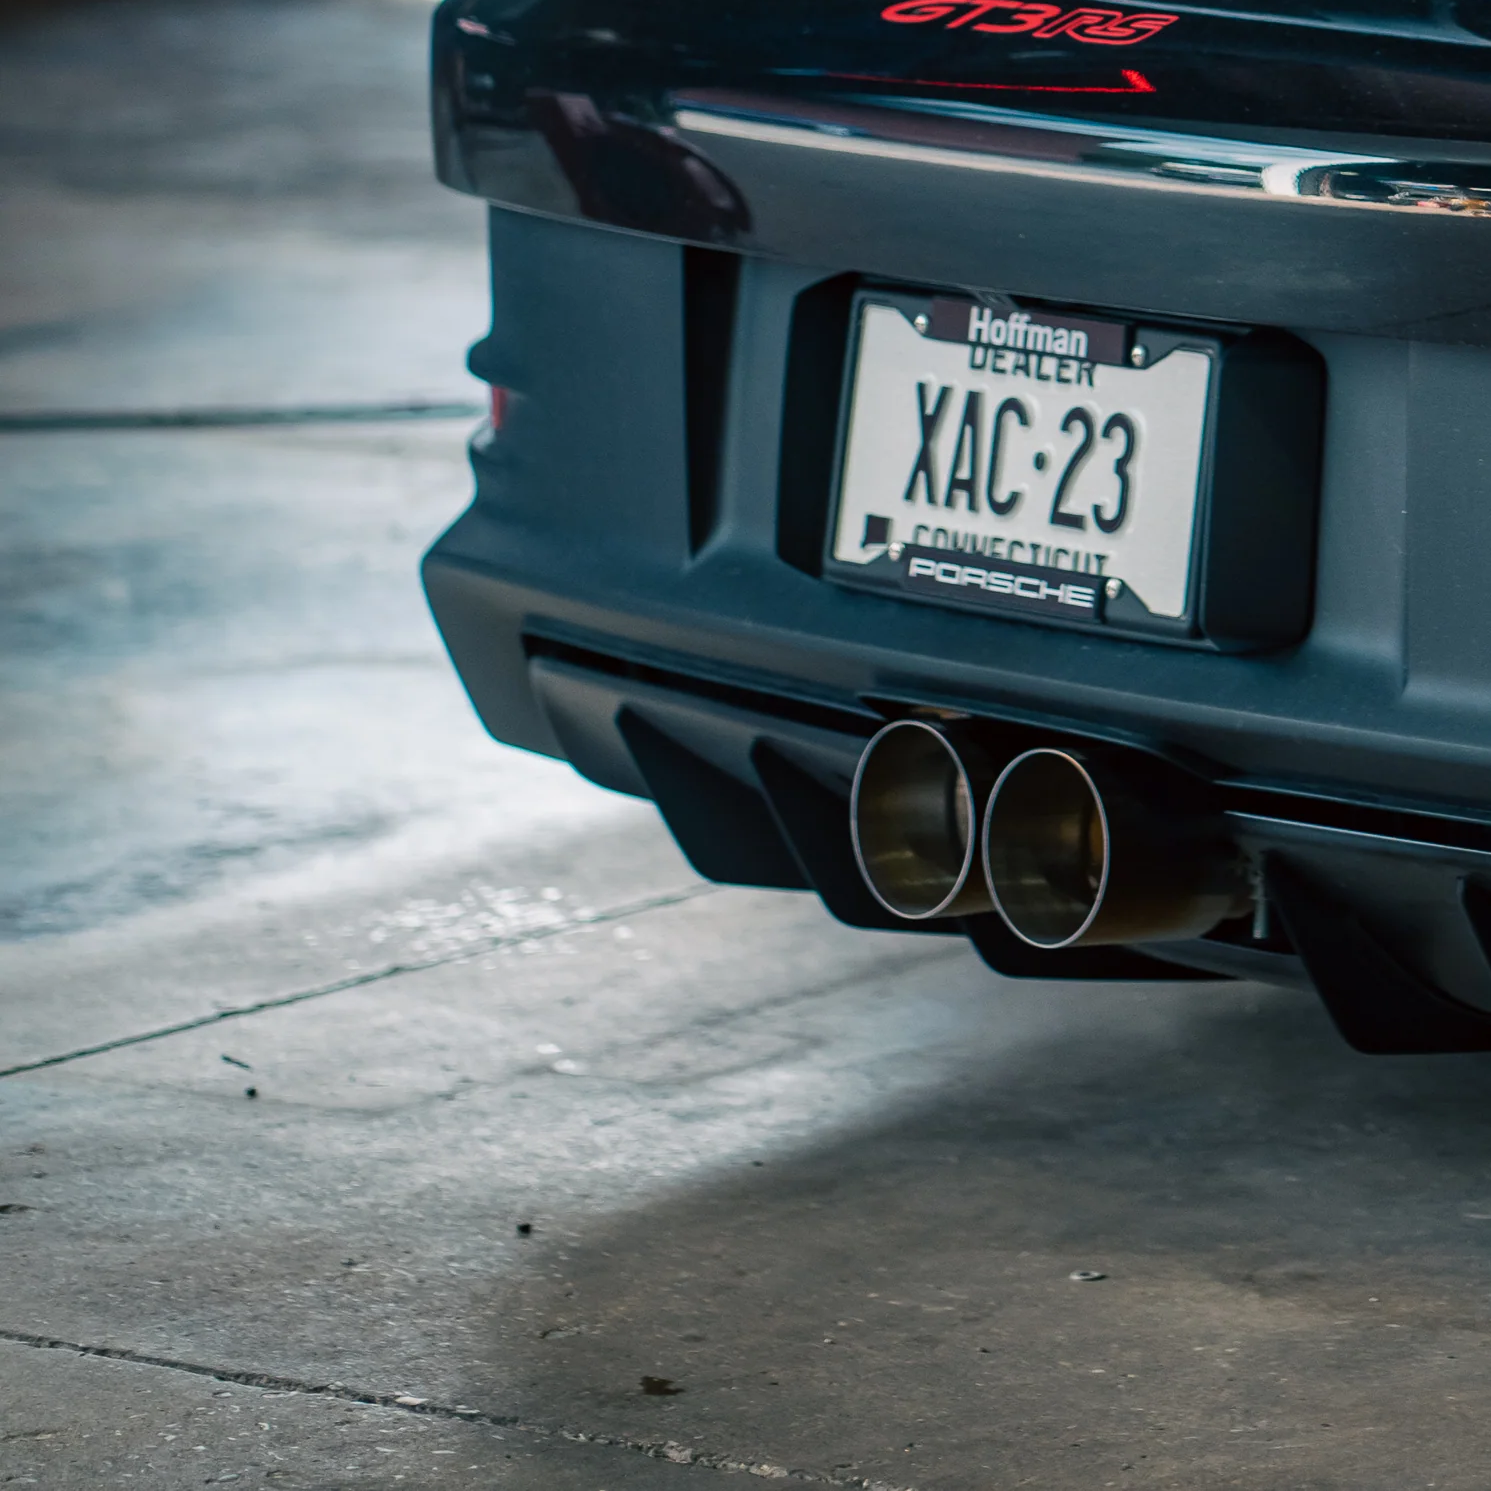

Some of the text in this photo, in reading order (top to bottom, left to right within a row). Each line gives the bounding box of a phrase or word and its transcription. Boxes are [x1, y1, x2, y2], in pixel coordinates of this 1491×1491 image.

[968, 306, 1089, 358] Hoffman
[969, 345, 1097, 388] DEALER
[908, 557, 1096, 608] PORSCHE
